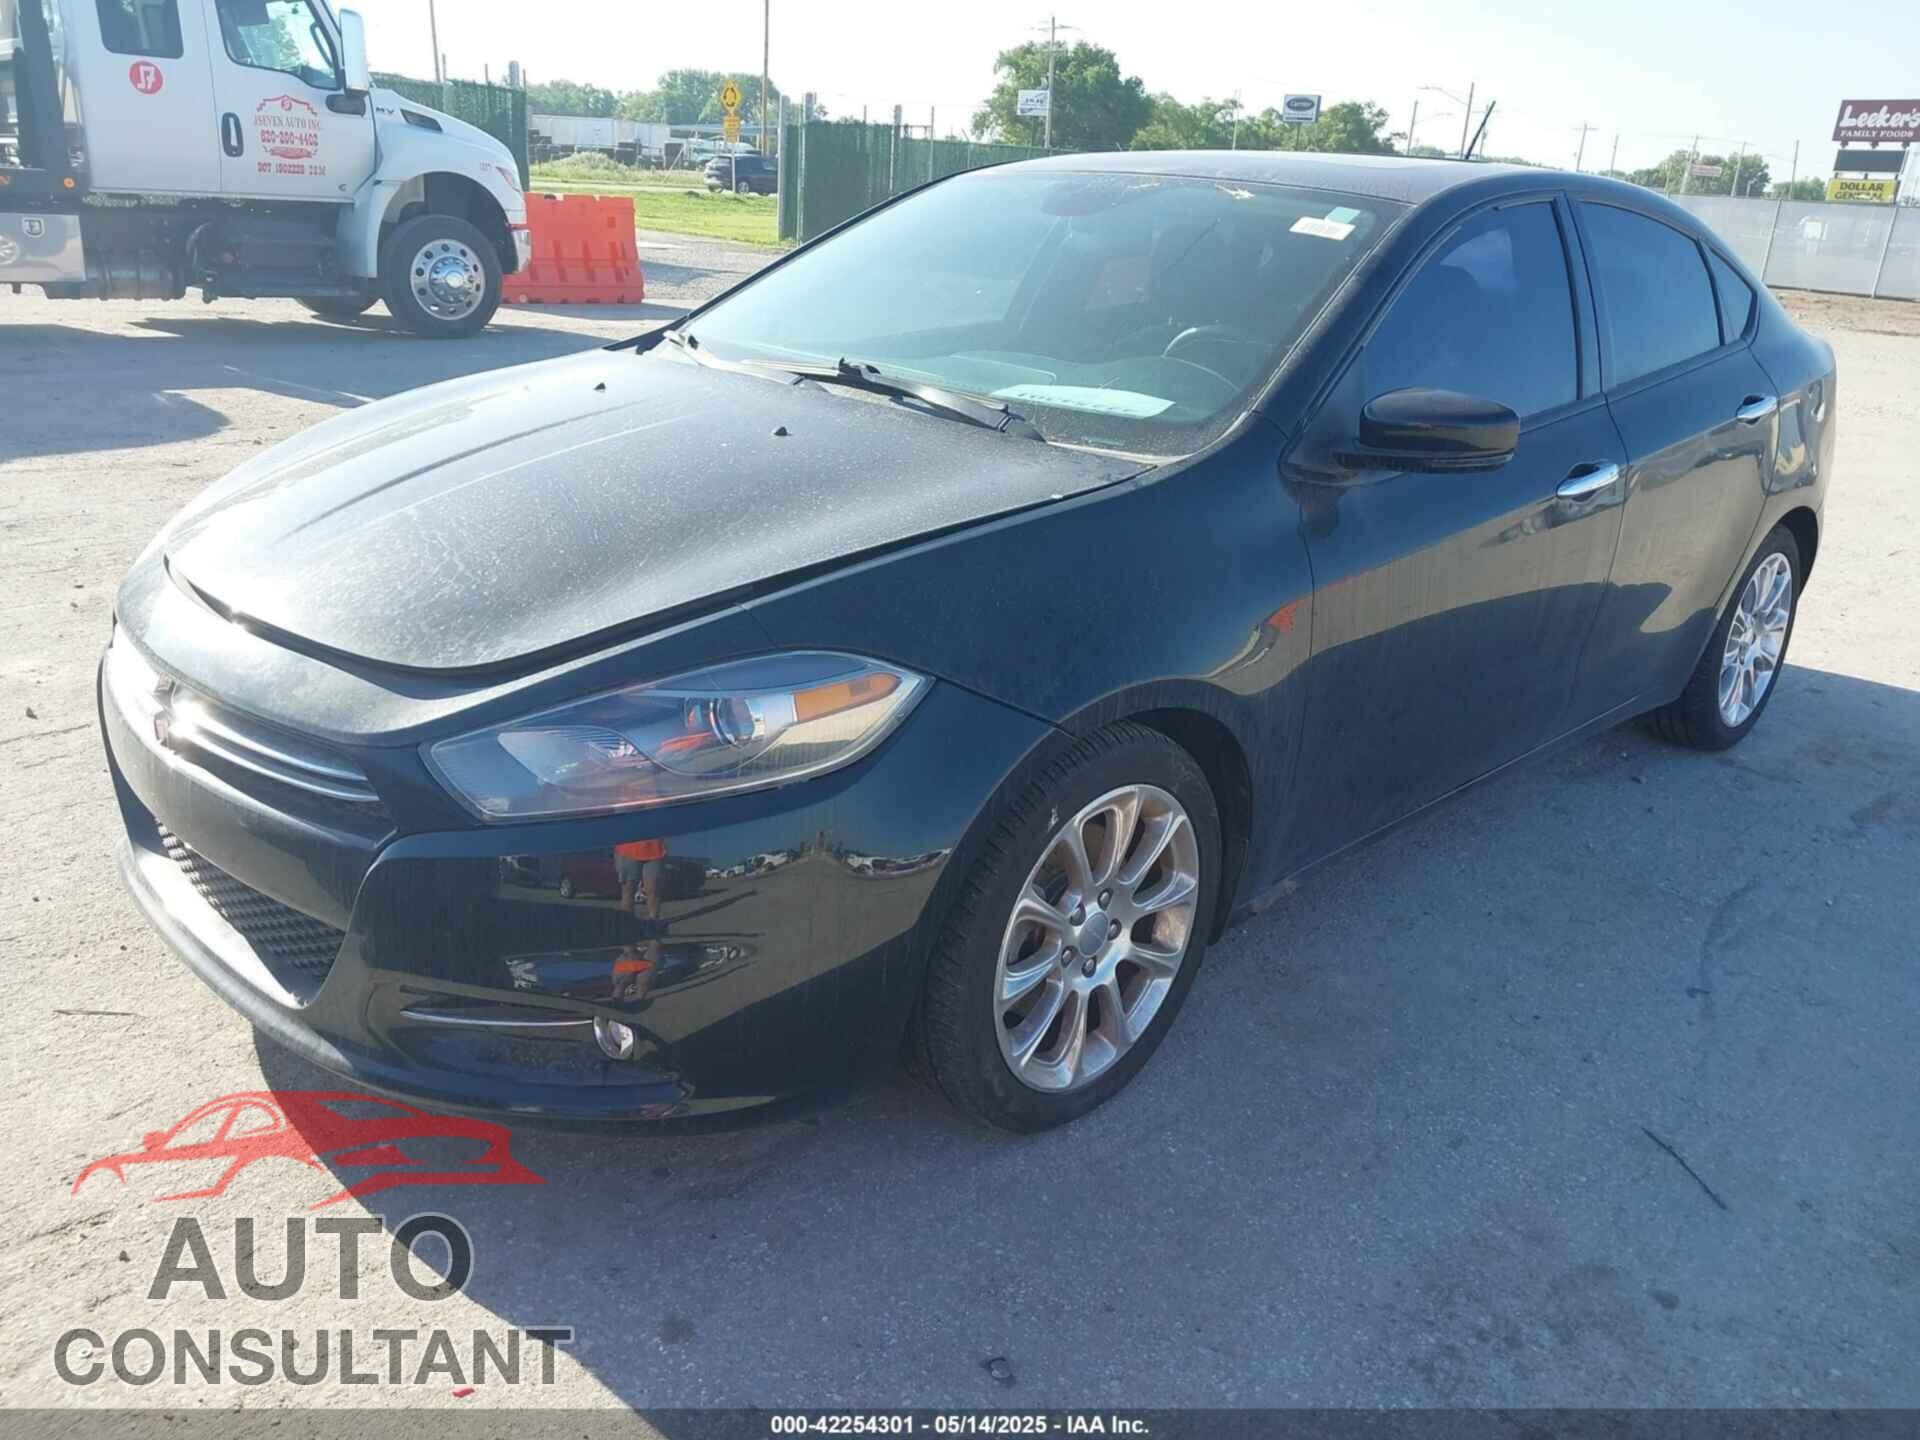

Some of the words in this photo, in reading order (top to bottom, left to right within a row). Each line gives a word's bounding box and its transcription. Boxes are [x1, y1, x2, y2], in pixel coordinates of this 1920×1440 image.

[1839, 105, 1920, 128] Leeker's
[1880, 130, 1914, 138] FOODS
[1839, 182, 1885, 191] DOLLAR
